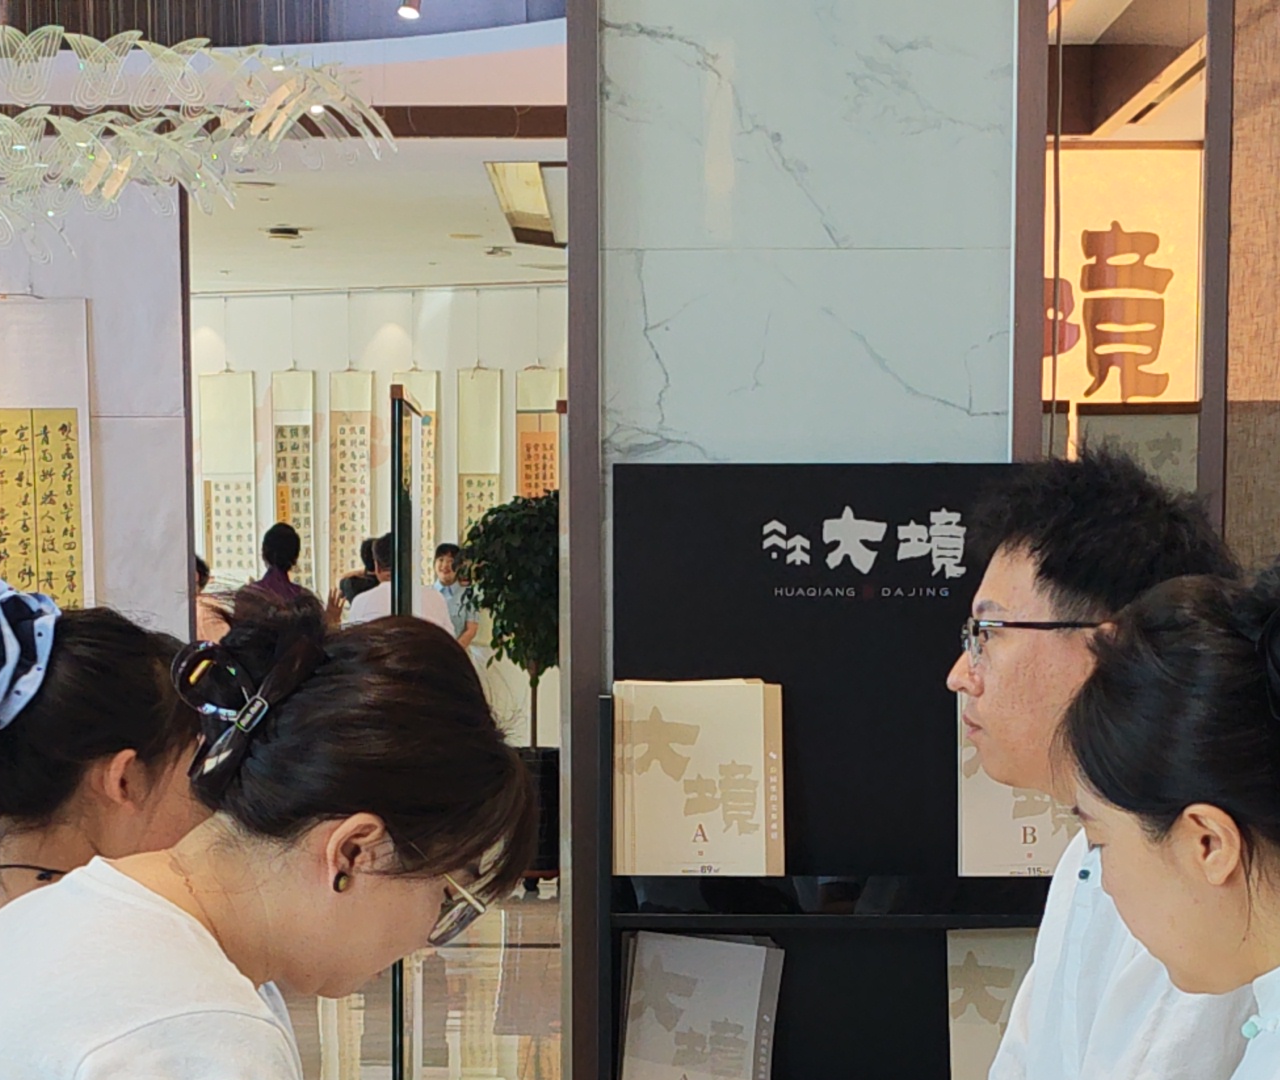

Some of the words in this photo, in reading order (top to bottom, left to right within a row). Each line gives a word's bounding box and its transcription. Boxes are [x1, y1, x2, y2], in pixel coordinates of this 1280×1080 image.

[823, 505, 966, 579] 大境
[774, 587, 855, 597] HUAQIANG
[881, 587, 949, 597] DAJING
[692, 823, 709, 843] A
[1022, 826, 1037, 845] B
